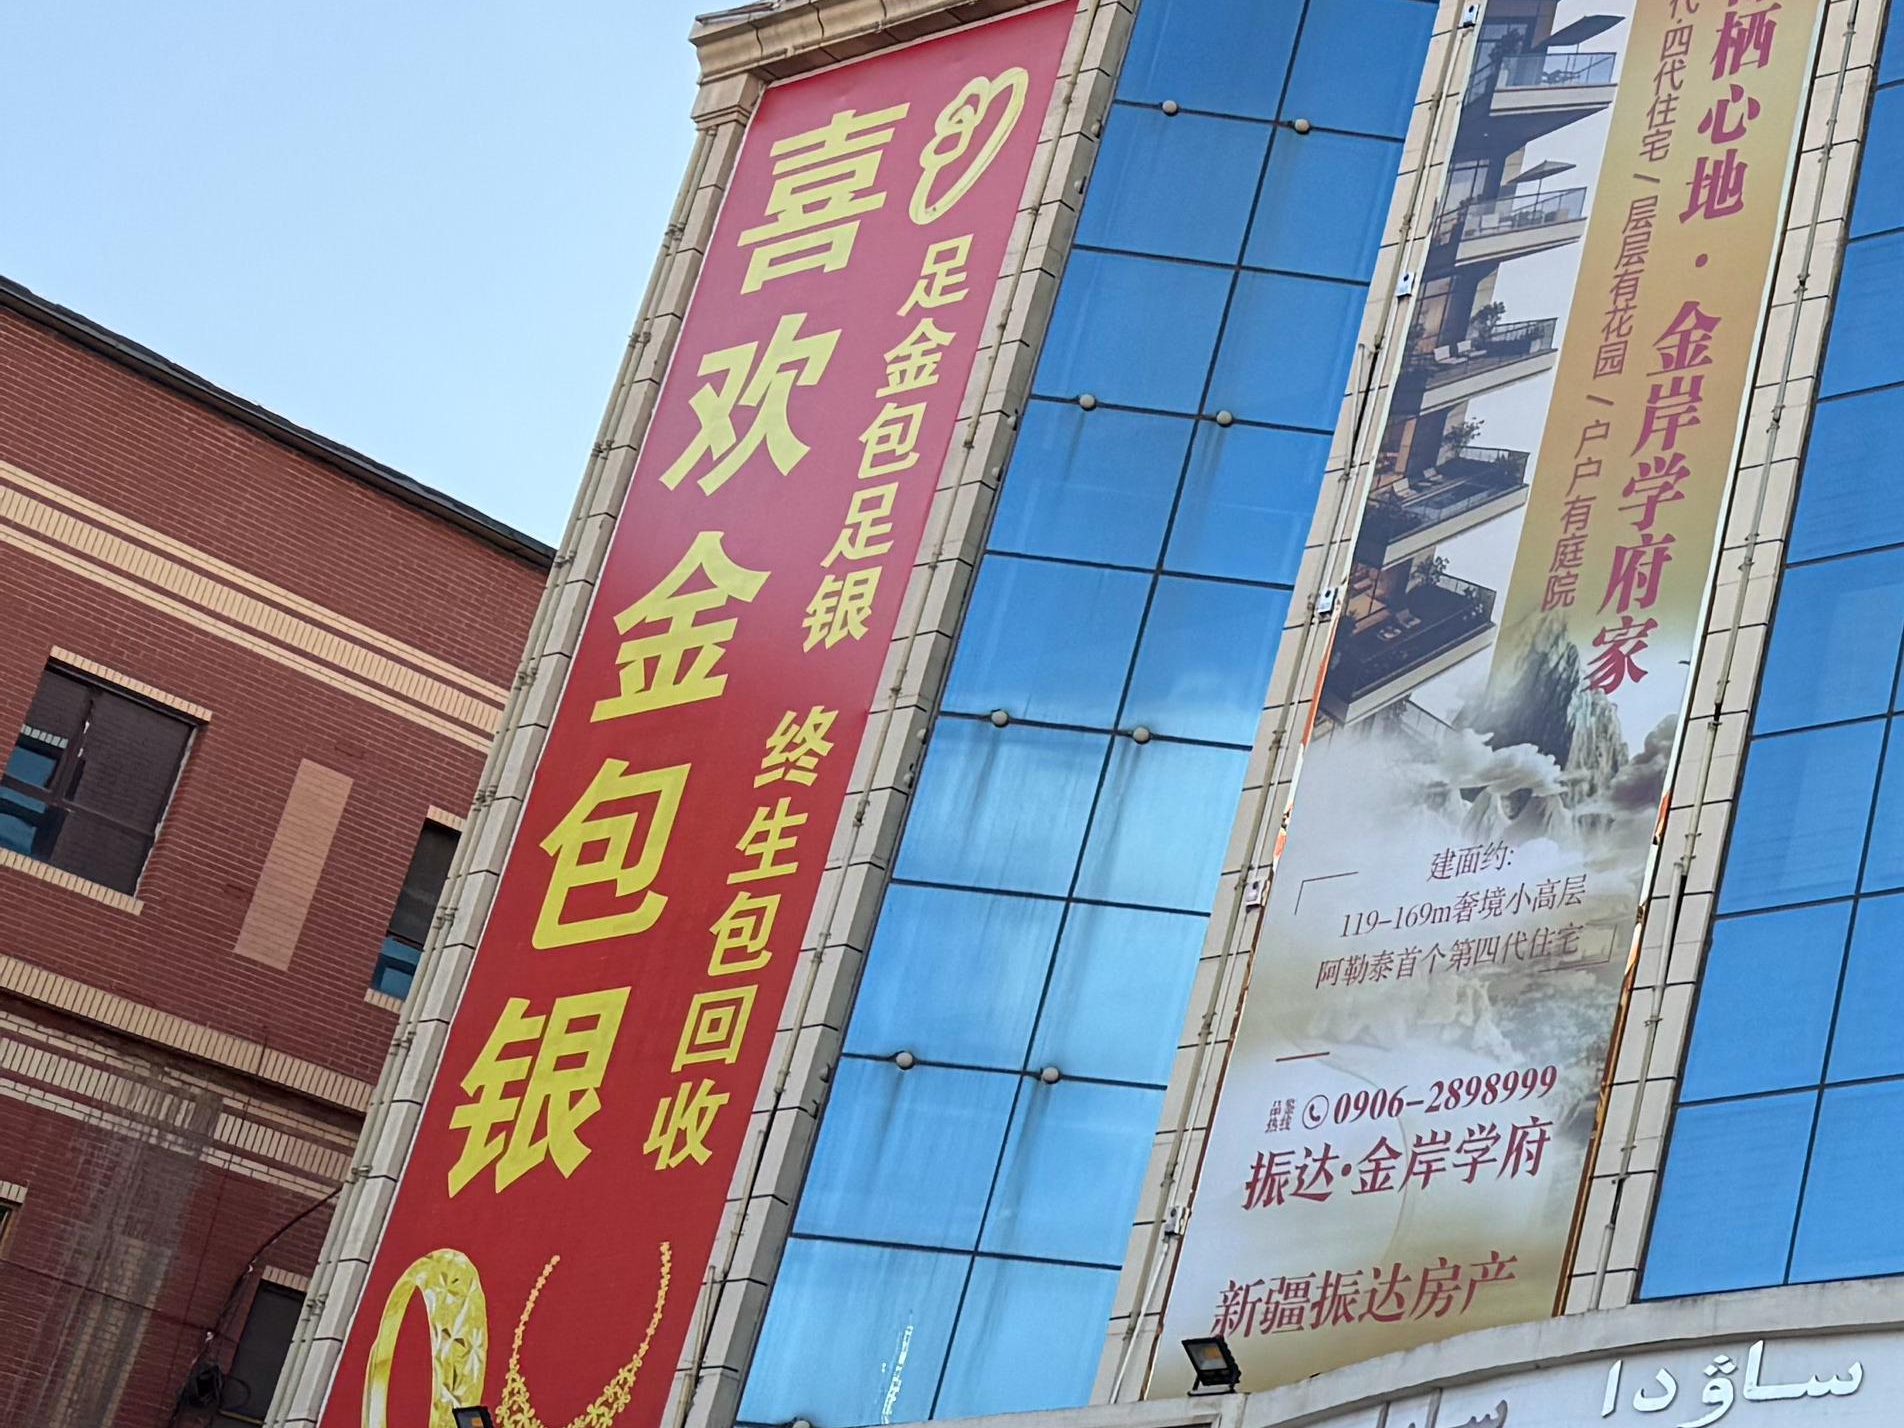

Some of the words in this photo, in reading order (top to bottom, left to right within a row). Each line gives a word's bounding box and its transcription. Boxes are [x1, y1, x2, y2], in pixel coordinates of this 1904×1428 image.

[1594, 196, 1657, 380] 层层有花园
[801, 233, 974, 653] 足金包足银
[1541, 419, 1609, 612] 户户有庭院
[447, 101, 909, 1199] 喜欢金包银
[642, 707, 836, 1171] 终生包回收
[1315, 922, 1583, 990] 阿勒泰首个第四代住宅
[1242, 1116, 1553, 1211] 振达·金岸学府
[1332, 1066, 1558, 1126] 0906-2898999
[1211, 1252, 1518, 1339] 新疆振达房产
